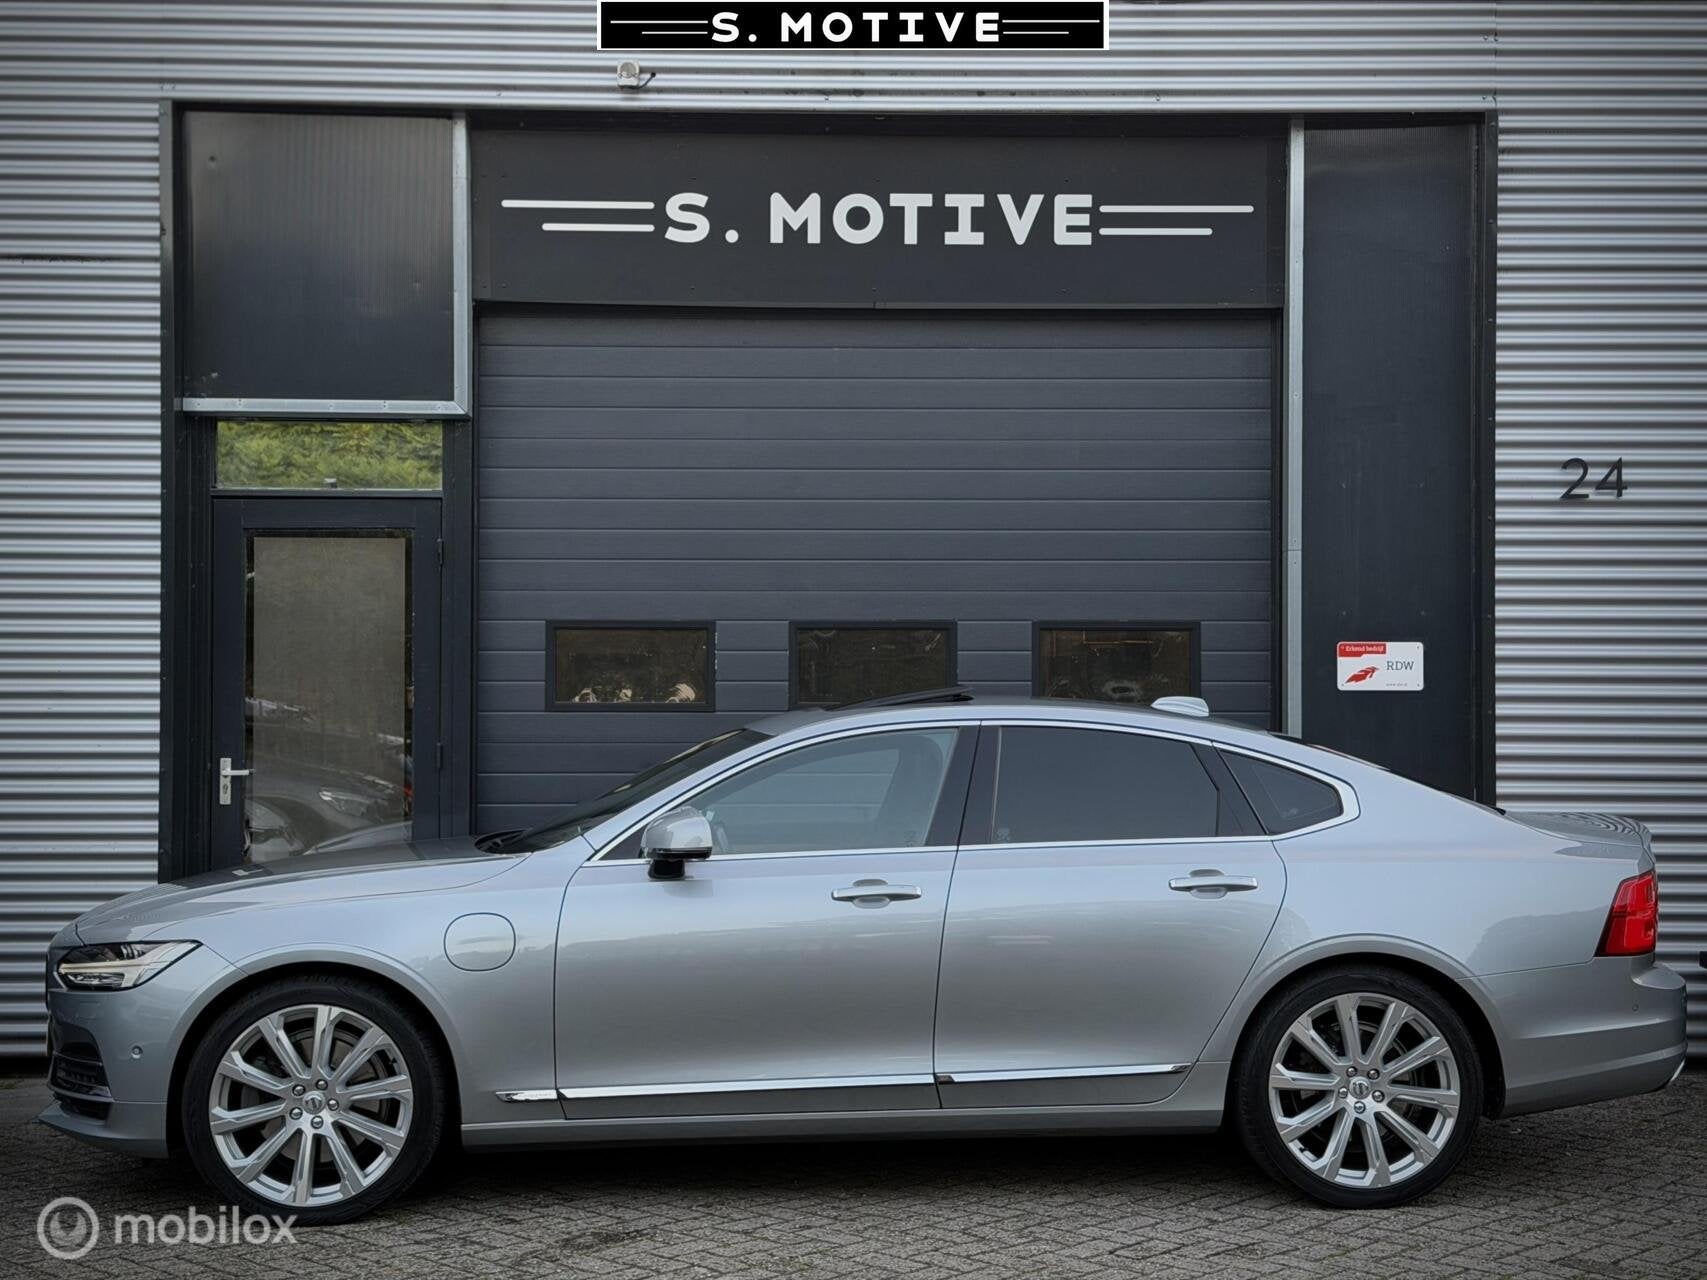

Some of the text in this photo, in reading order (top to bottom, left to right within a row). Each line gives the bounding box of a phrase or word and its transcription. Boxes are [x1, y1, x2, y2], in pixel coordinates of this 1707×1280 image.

[664, 192, 1093, 246] S. MOTIVE
[1560, 456, 1628, 499] 24
[1386, 661, 1414, 671] RDW
